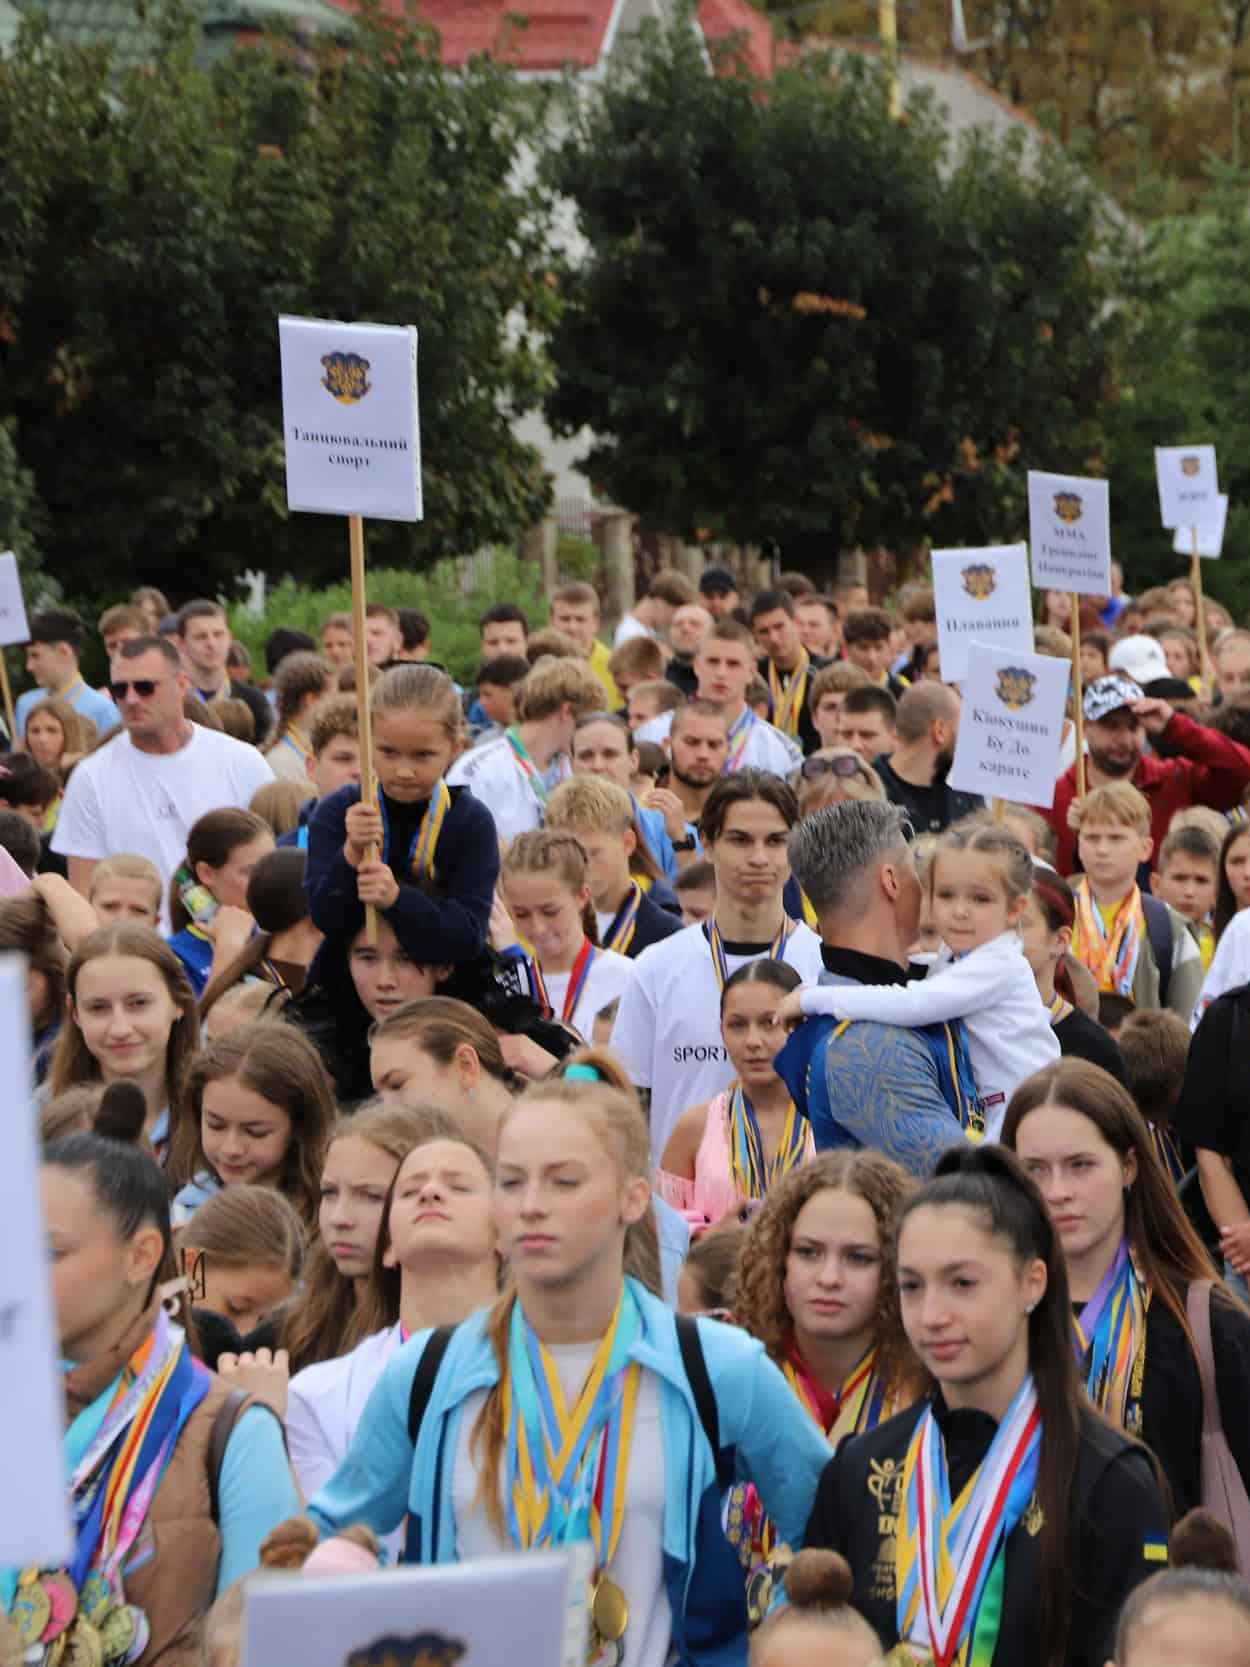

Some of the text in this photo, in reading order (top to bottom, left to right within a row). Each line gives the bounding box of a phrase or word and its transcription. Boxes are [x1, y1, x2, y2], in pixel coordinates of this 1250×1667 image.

[292, 426, 407, 450] Танцювальний
[328, 455, 370, 470] спорт
[945, 618, 1020, 633] Плавання
[973, 708, 1049, 736] Кіокушин
[979, 760, 1031, 780] карате
